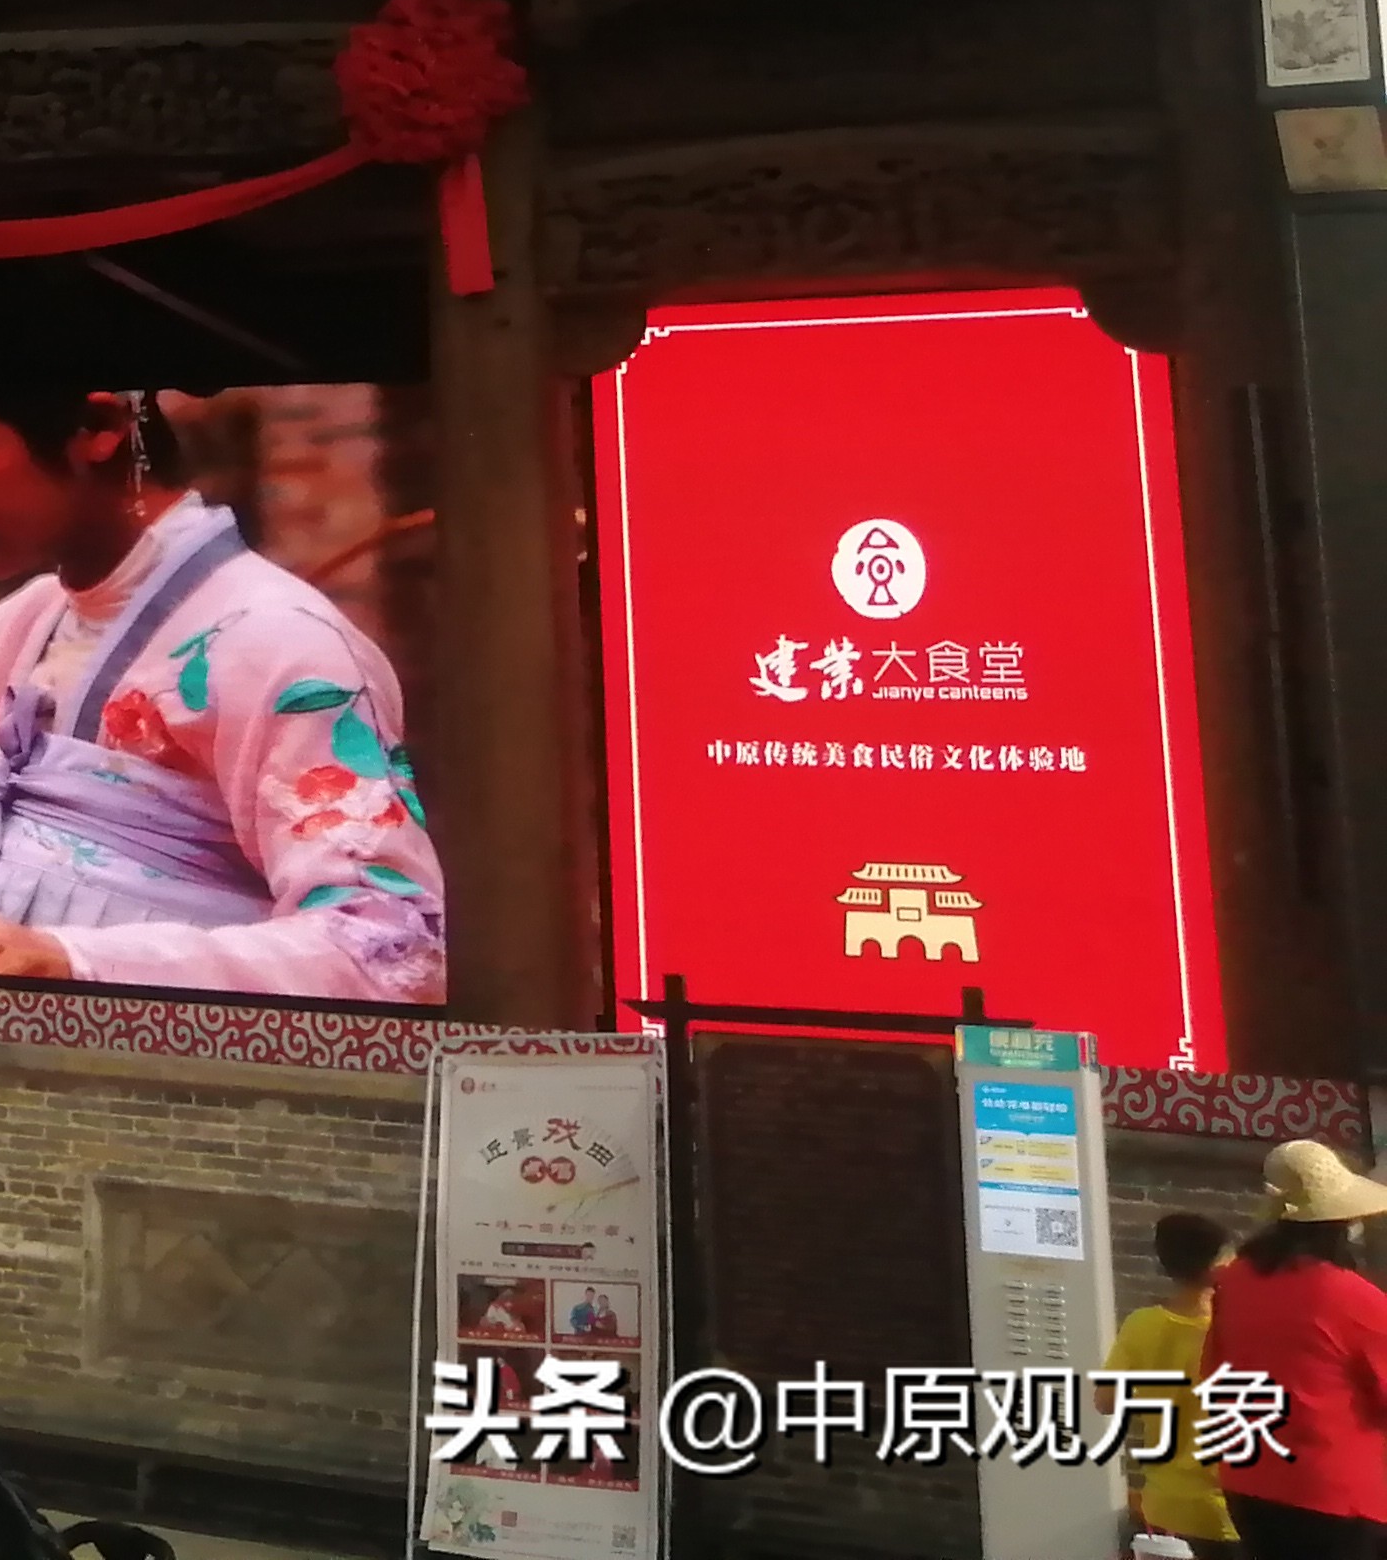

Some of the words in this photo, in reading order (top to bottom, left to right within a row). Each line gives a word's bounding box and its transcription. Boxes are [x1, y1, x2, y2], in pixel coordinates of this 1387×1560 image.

[938, 685, 1029, 701] canteens
[707, 738, 1088, 773] 中原传统美食民俗文化体验地
